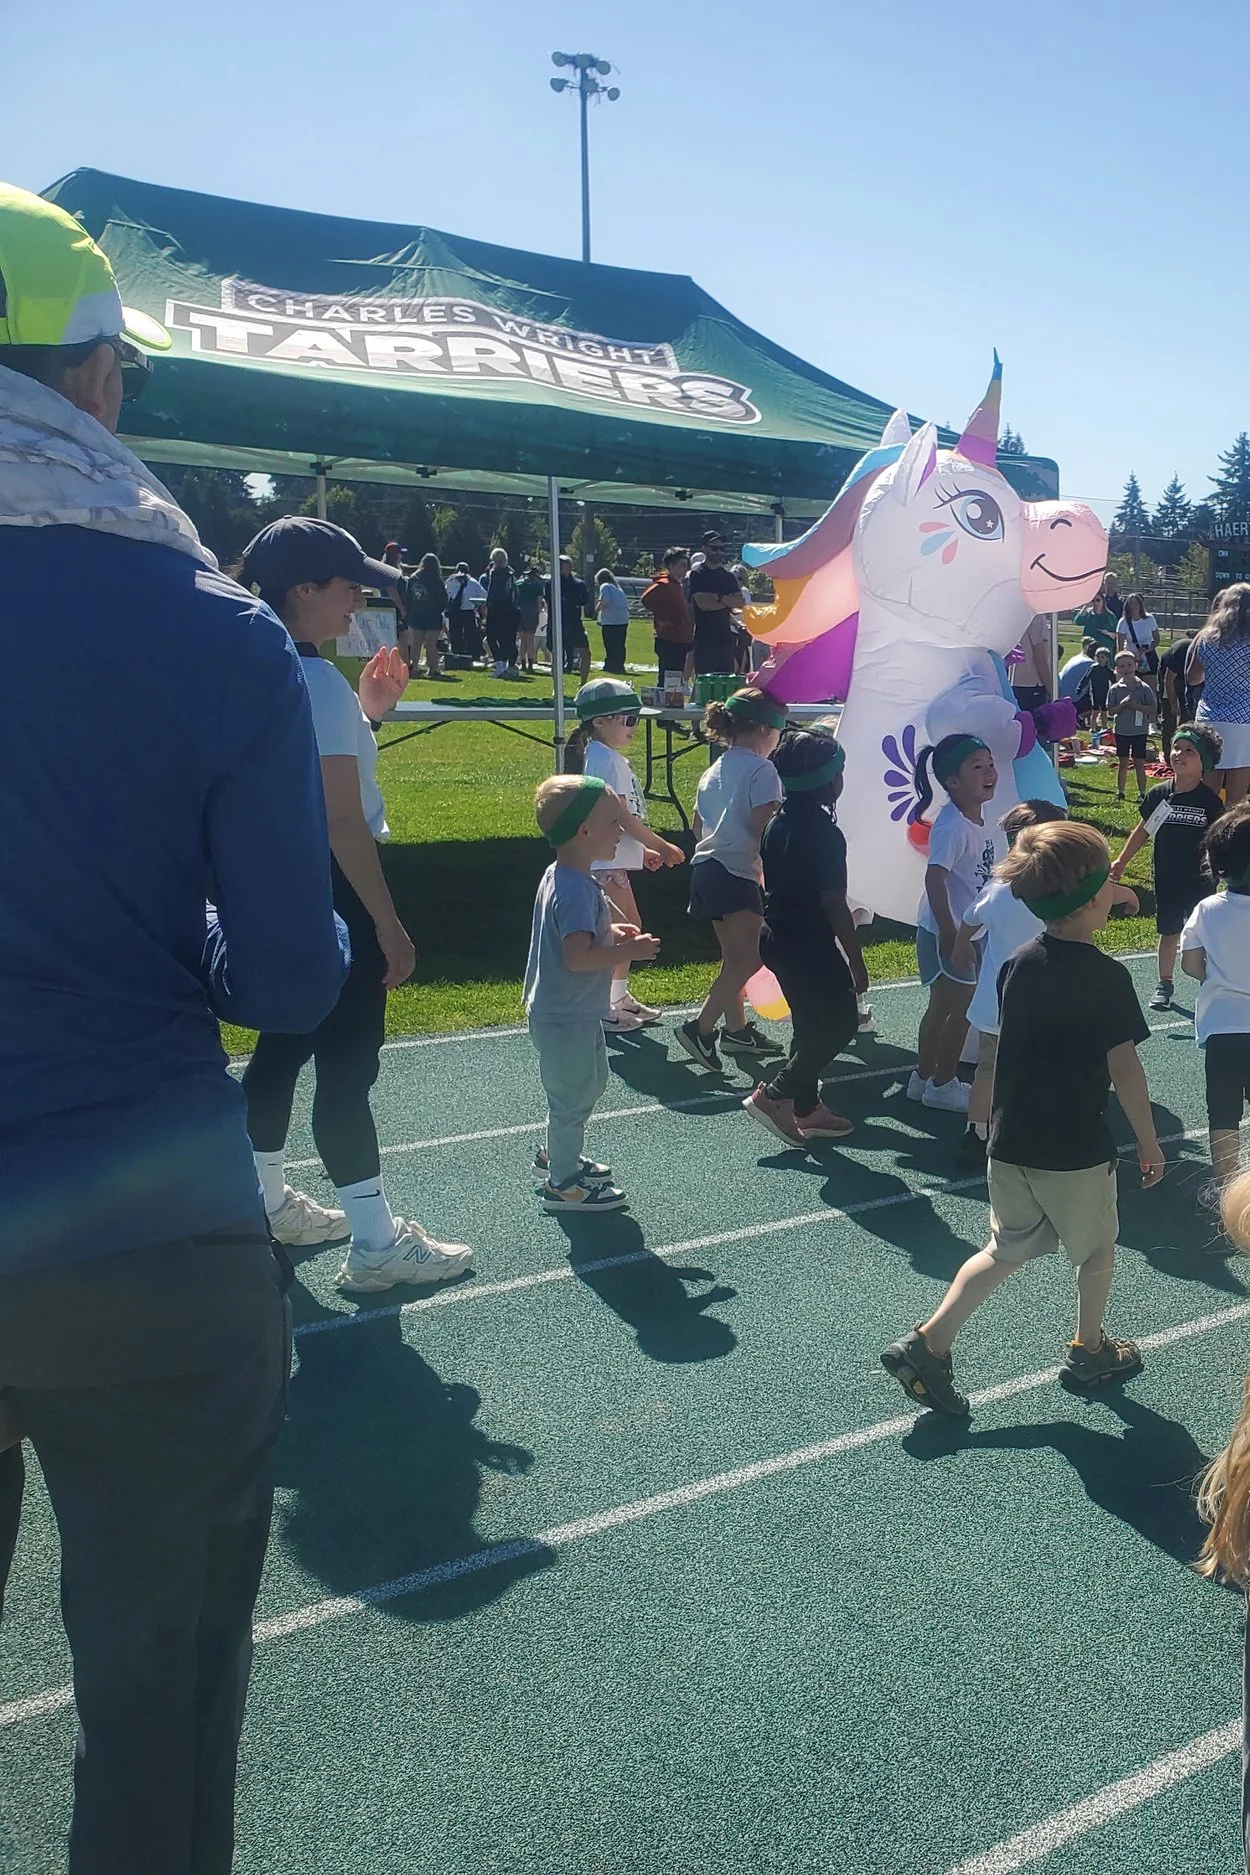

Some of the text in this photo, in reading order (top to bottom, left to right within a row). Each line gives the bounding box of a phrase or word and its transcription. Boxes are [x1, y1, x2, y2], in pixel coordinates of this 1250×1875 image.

[189, 312, 746, 418] TARRIERS
[248, 293, 656, 365] CHARLES WRIGHT
[1167, 813, 1207, 824] RRIERS
